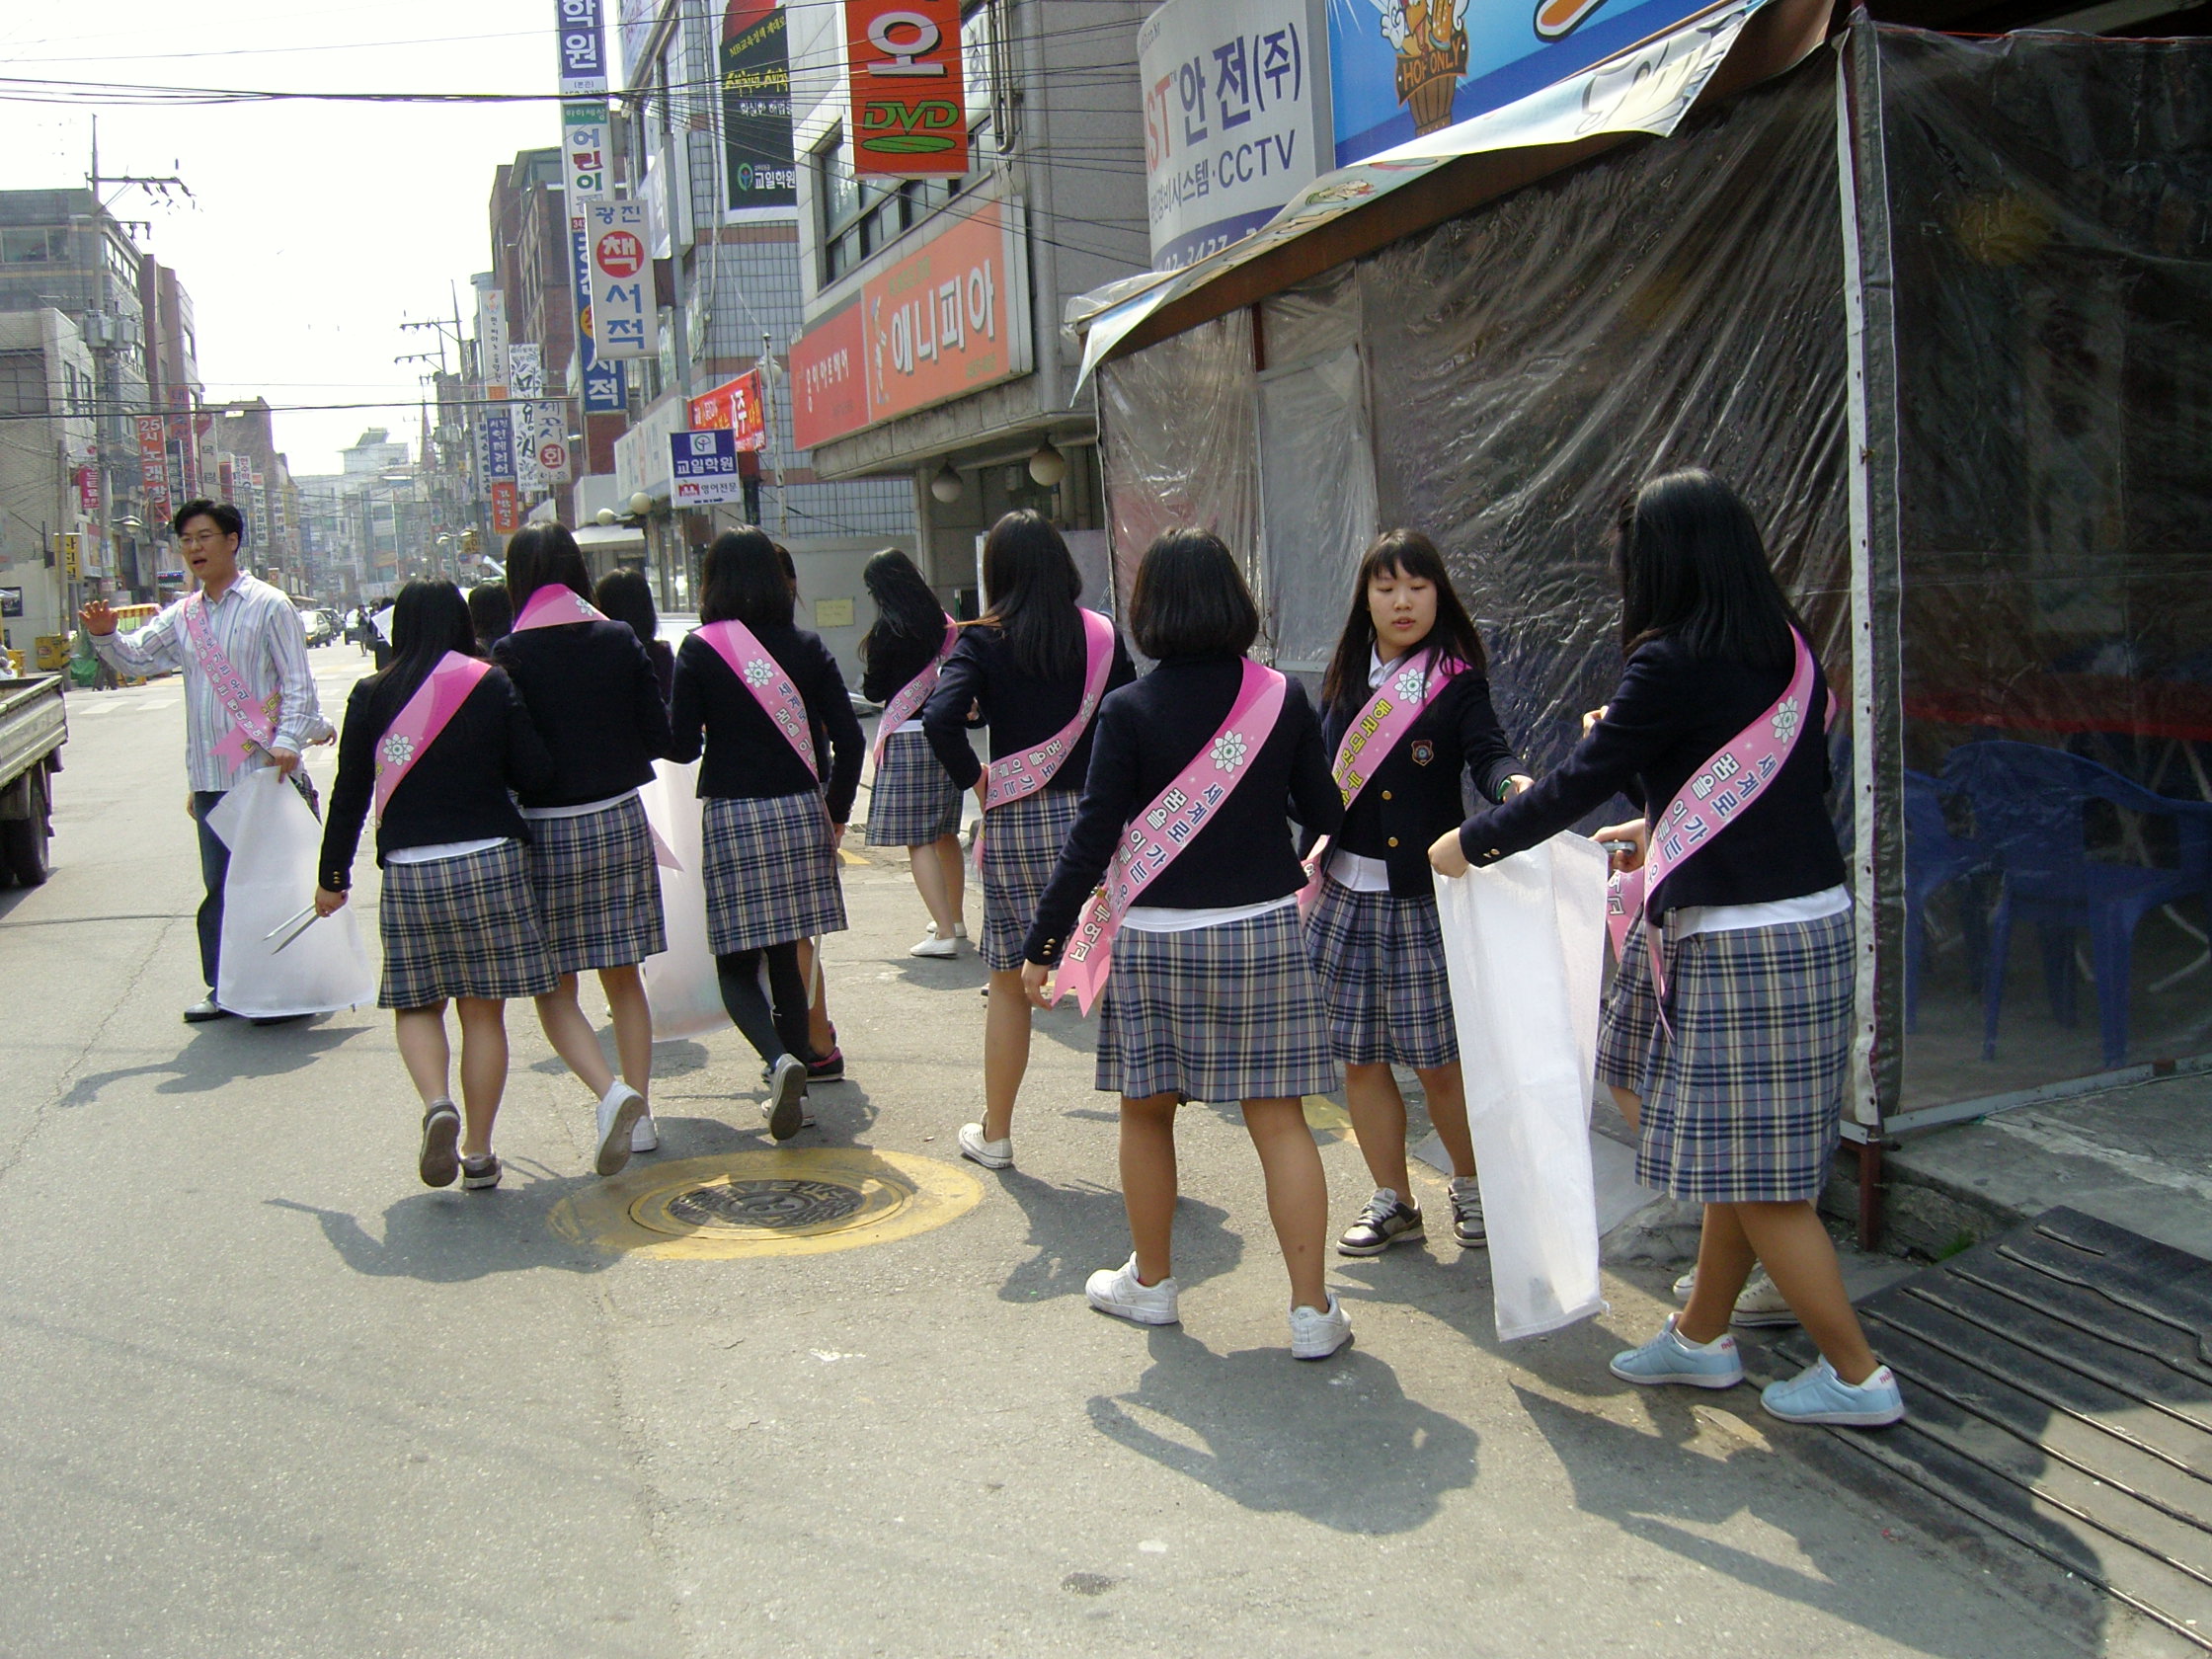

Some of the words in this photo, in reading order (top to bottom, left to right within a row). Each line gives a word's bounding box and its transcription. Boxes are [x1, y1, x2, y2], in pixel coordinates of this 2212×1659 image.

[1430, 37, 1462, 74] ONLY
[862, 100, 959, 135] DVD
[754, 170, 797, 190] 교일학원
[595, 205, 641, 225] 광진
[602, 236, 637, 272] 책
[143, 445, 168, 504] 노래방
[676, 455, 734, 474] 교일학원
[701, 482, 738, 495] 영어전문
[775, 707, 801, 738] 꿈을
[1028, 739, 1063, 767] 꿈을
[1003, 774, 1036, 796] 가는
[1690, 750, 1741, 801] 꿈을
[1711, 752, 1779, 817] 세계로
[1146, 787, 1188, 831] 꿈을
[1167, 782, 1224, 845] 세계로
[1663, 814, 1708, 864] 가는
[1130, 843, 1169, 885] 가는
